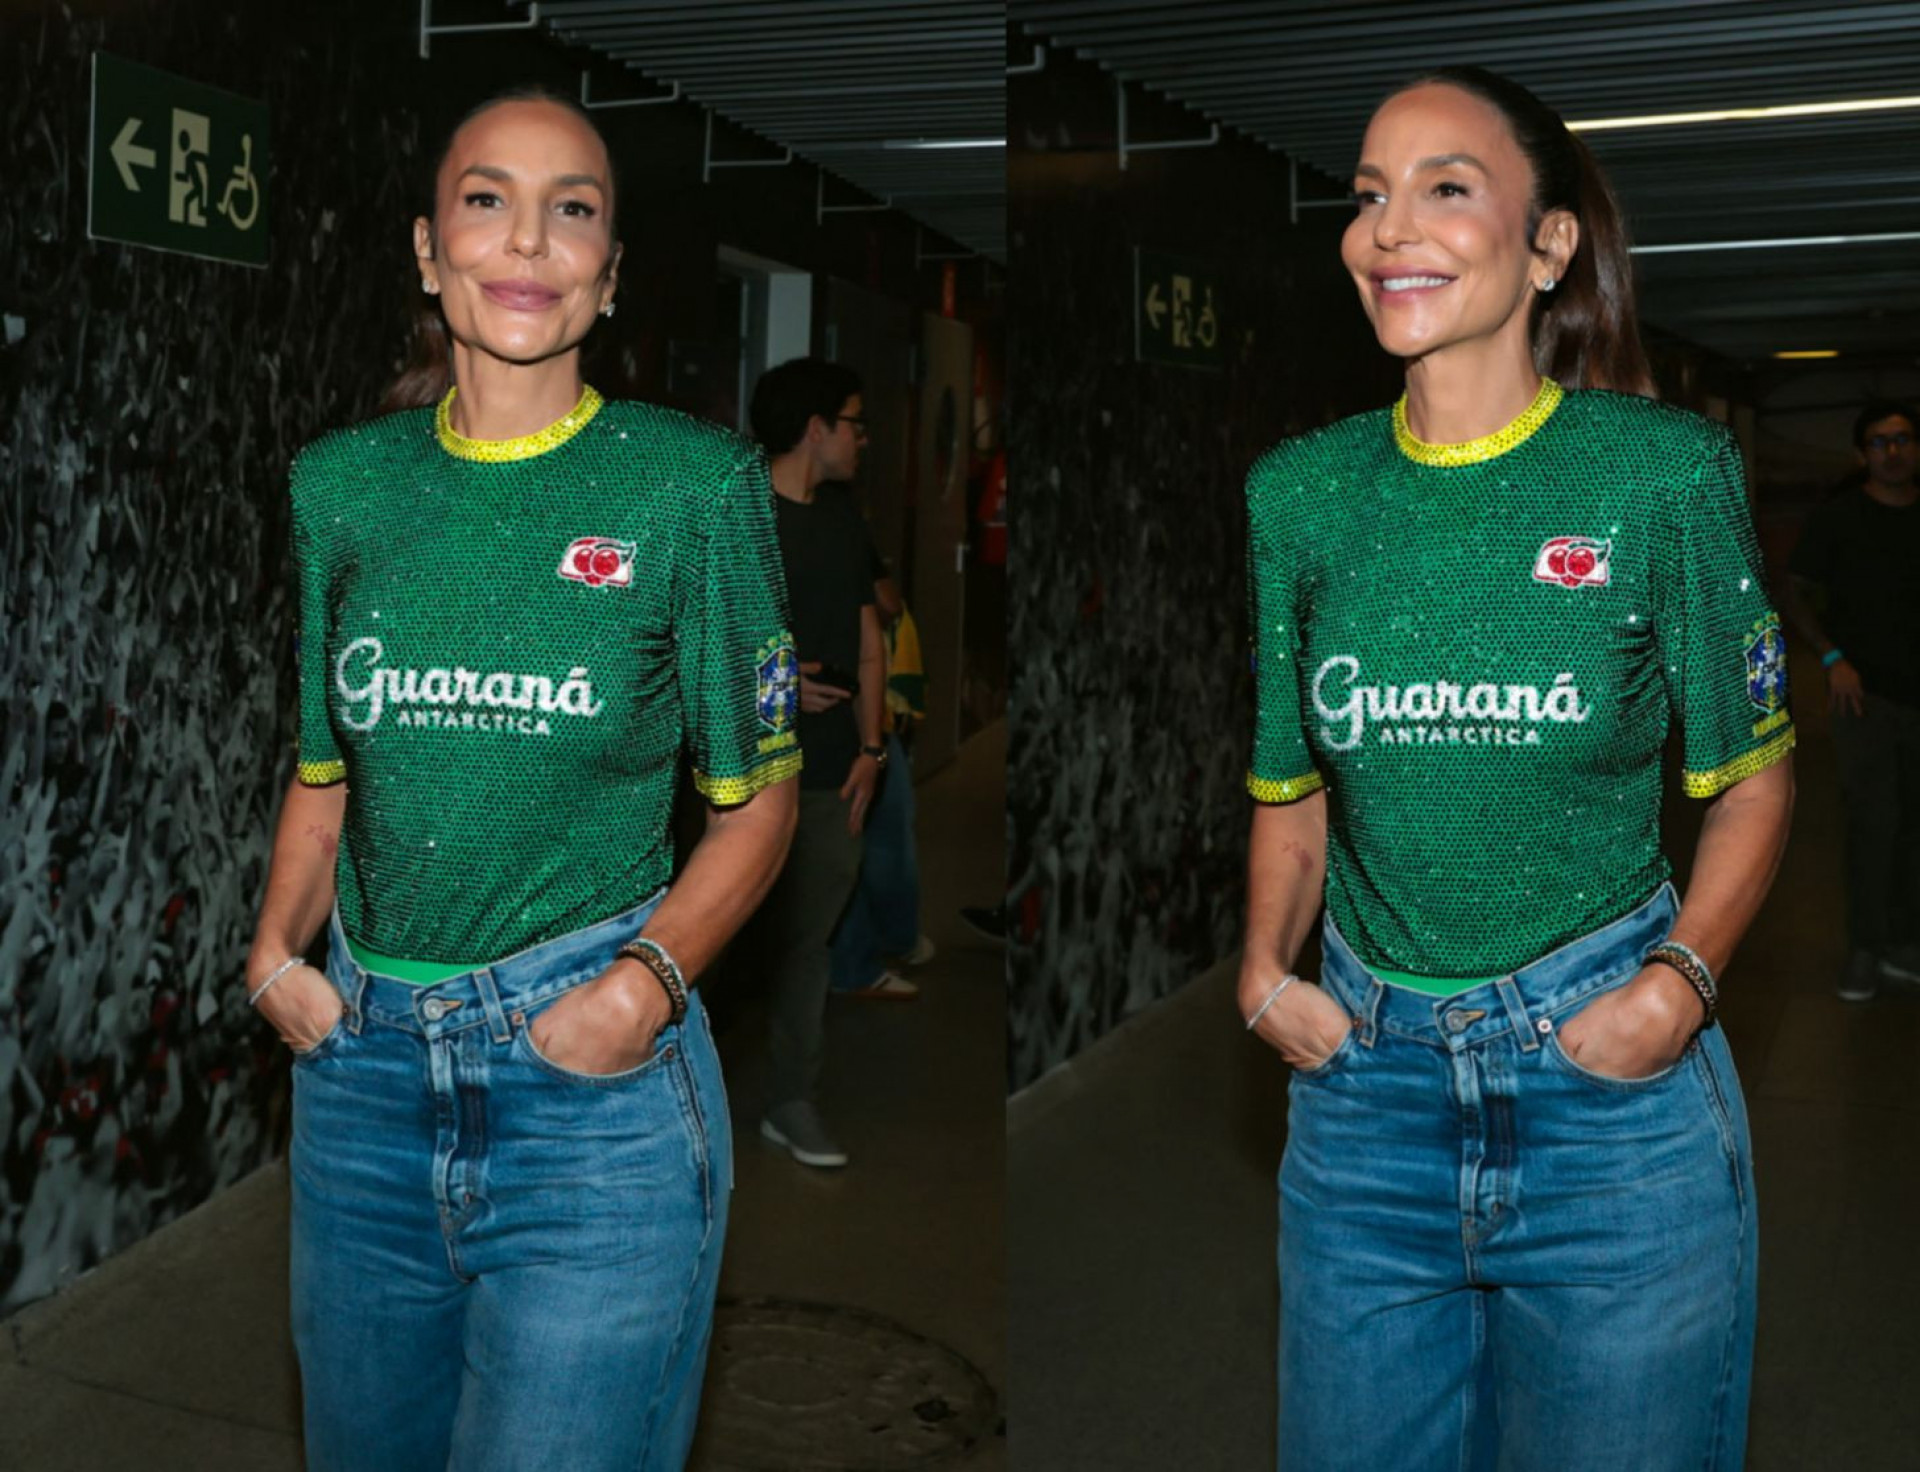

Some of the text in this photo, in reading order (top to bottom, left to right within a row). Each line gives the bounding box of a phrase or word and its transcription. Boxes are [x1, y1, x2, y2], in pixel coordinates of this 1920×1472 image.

[335, 637, 601, 730] Guaraná
[1312, 655, 1590, 750] Guaraná
[397, 710, 550, 735] ANTARCTICA
[1380, 726, 1540, 744] ANTARCTICA
